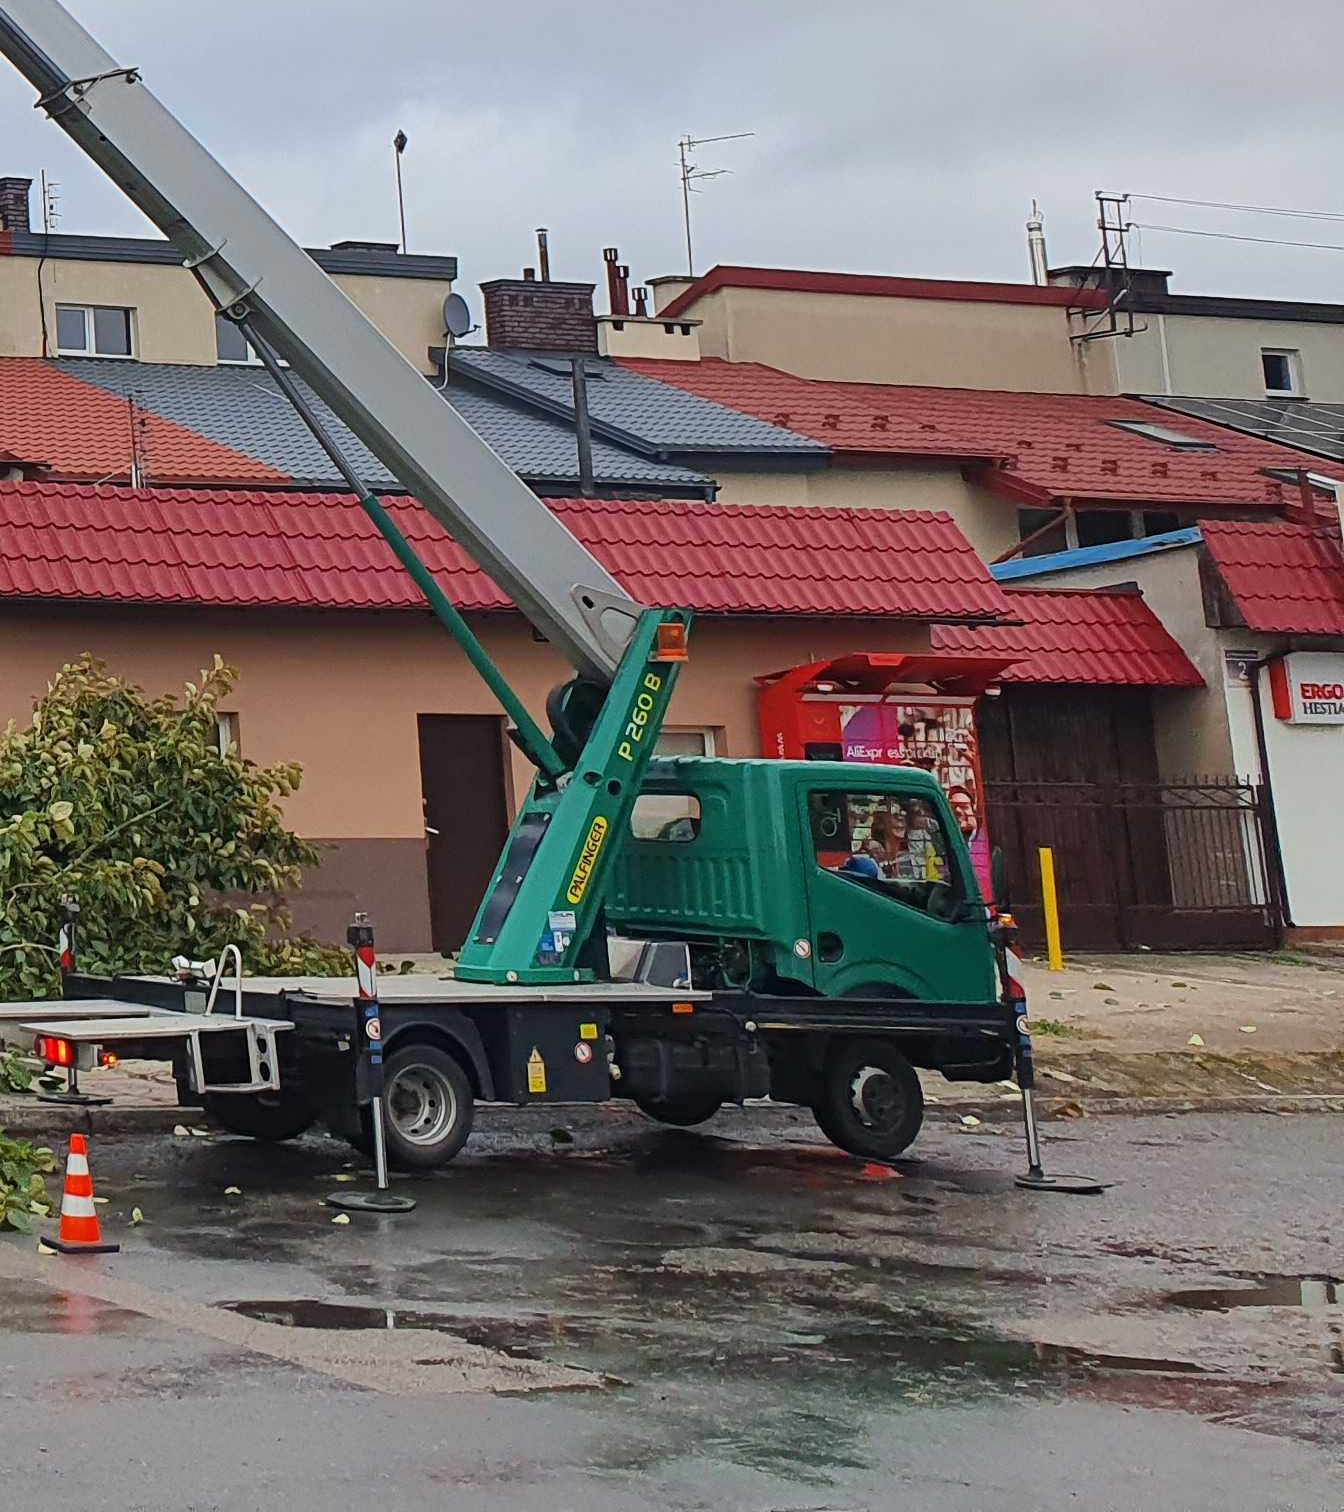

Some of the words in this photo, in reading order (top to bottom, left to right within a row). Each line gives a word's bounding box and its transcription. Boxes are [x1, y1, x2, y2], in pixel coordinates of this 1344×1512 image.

[1238, 661, 1249, 681] 2
[644, 672, 662, 691] B
[1300, 683, 1344, 699] ERGO
[625, 693, 654, 742] 260
[618, 742, 633, 761] P
[569, 821, 605, 899] PALFINGER
